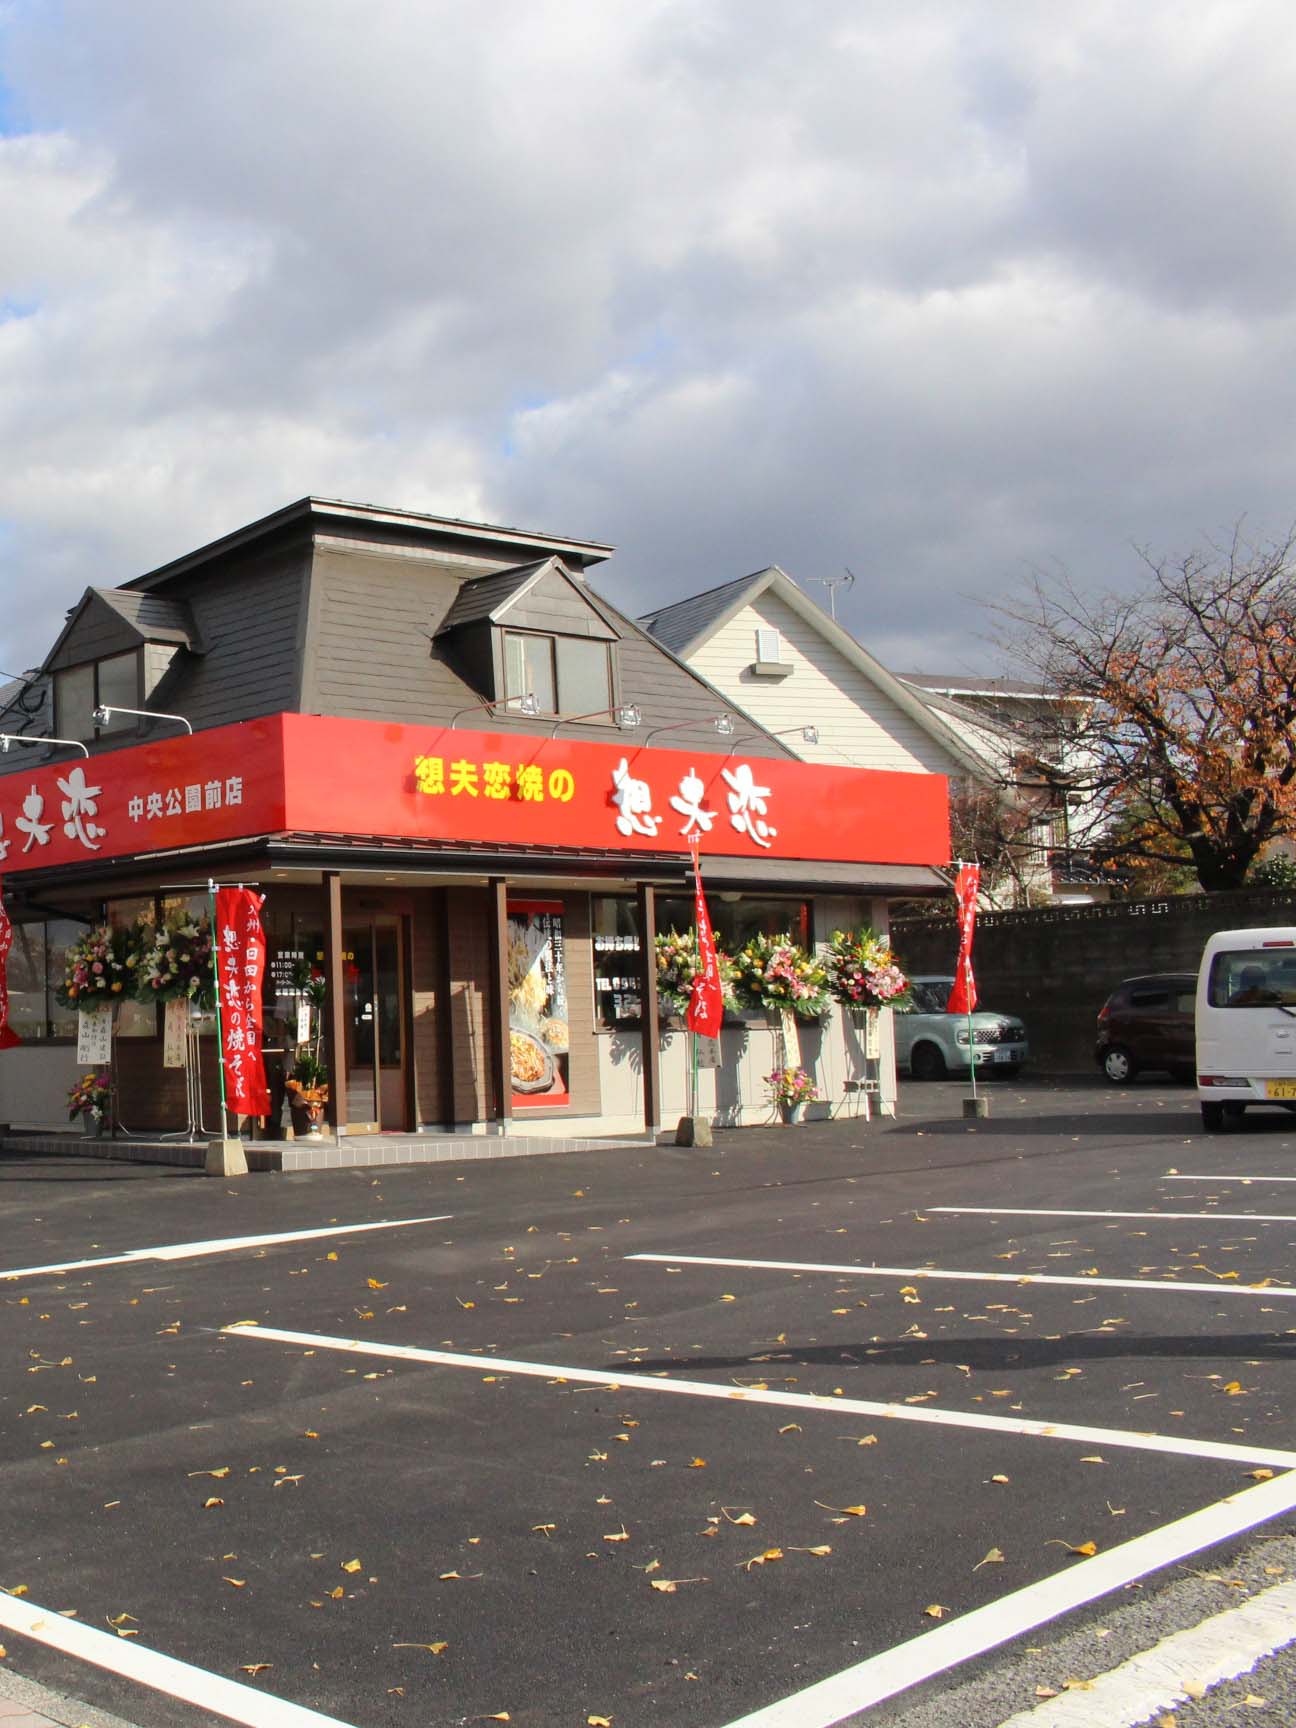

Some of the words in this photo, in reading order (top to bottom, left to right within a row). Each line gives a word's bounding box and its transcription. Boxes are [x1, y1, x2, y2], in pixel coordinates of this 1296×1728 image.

[127, 777, 244, 823] 中央公園前店
[415, 755, 575, 803] 想夫恋焼の
[611, 757, 777, 848] 想夫恋
